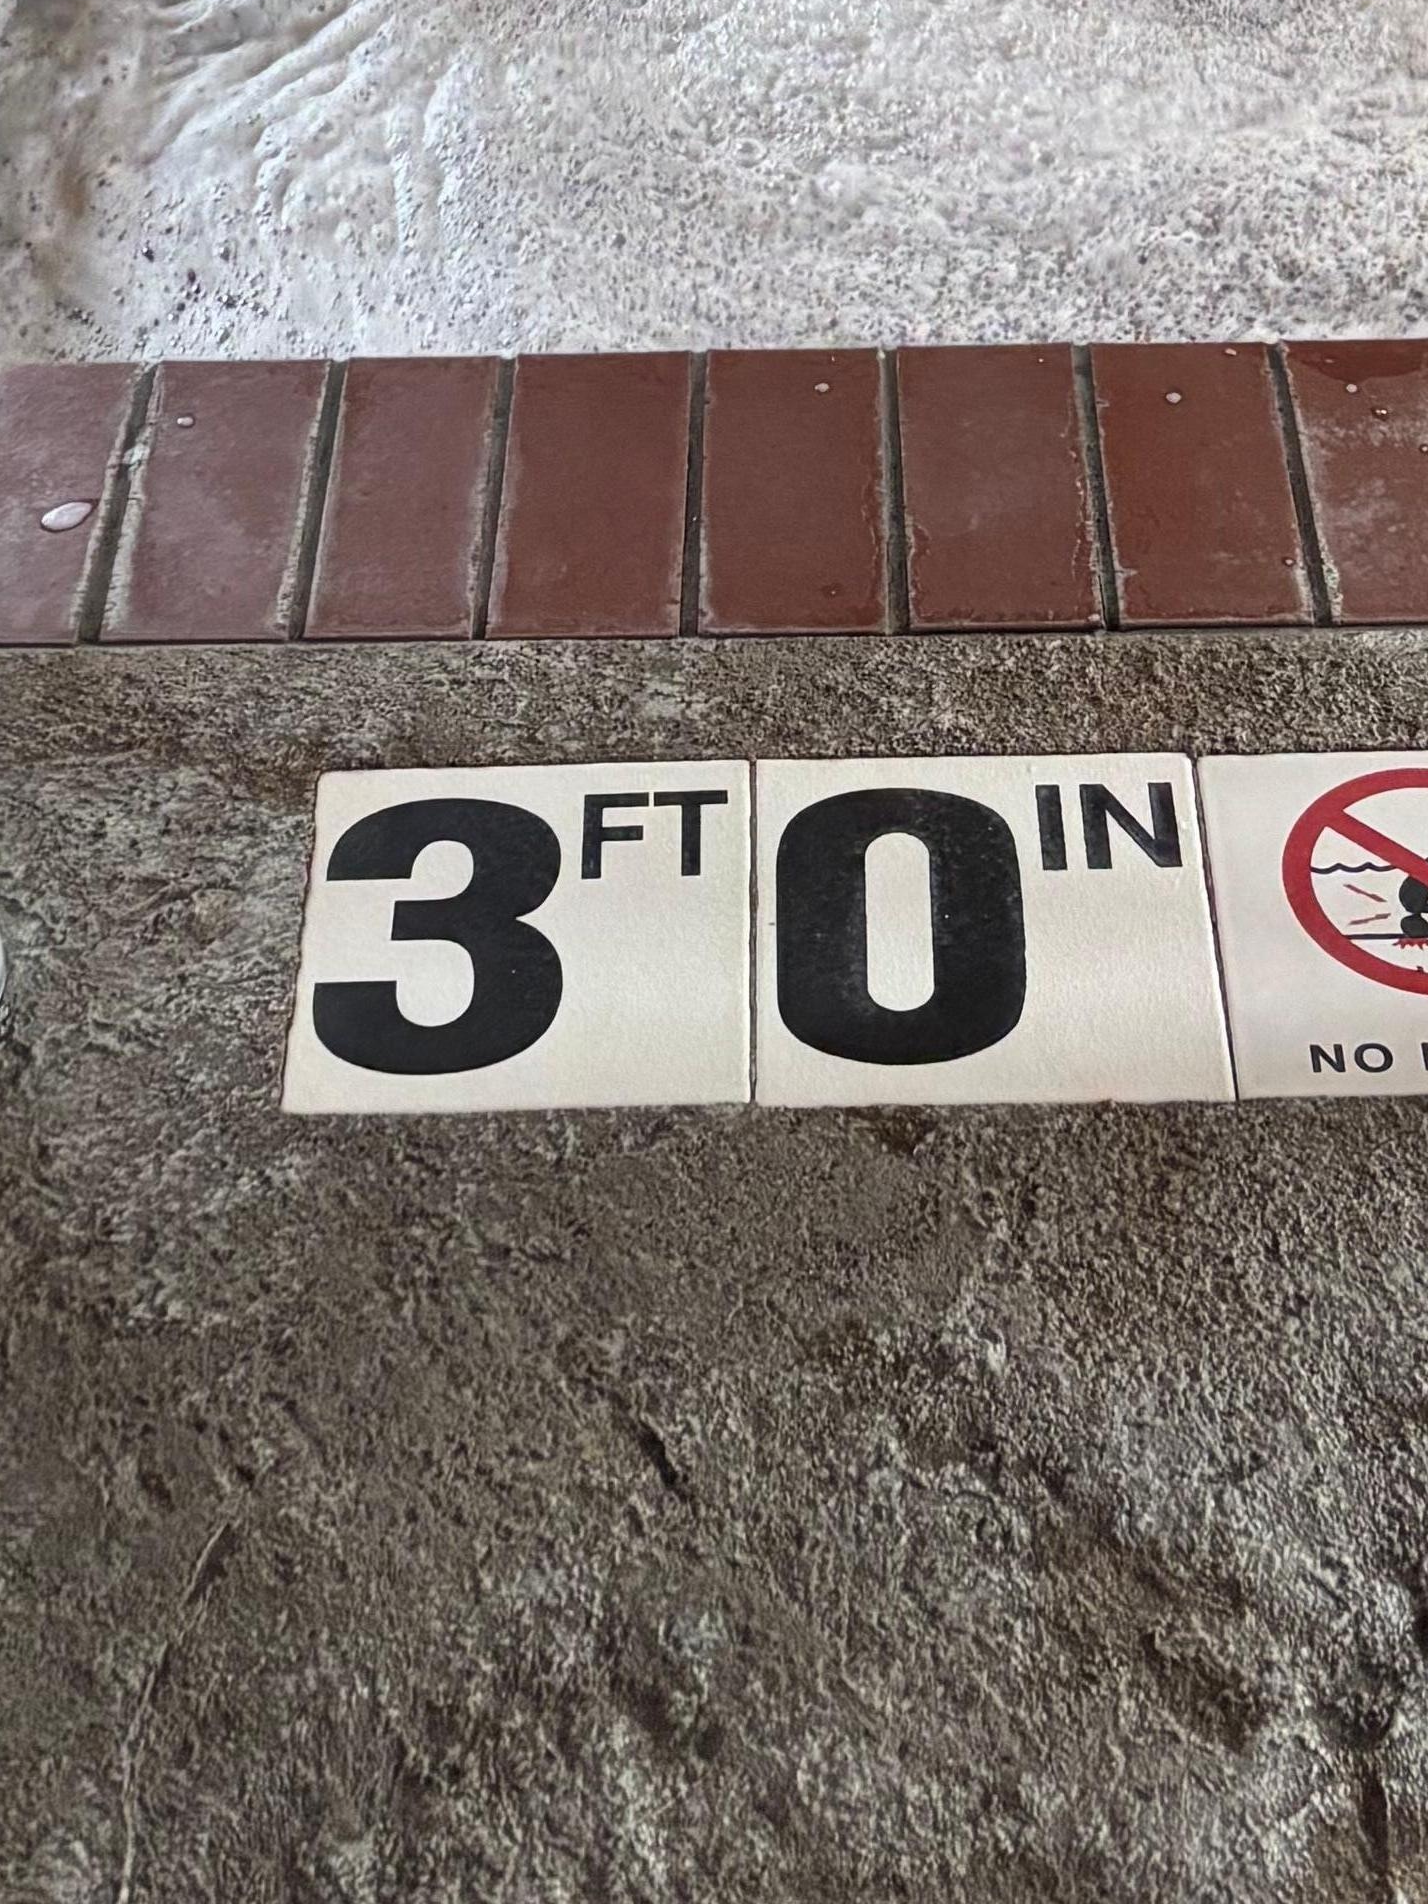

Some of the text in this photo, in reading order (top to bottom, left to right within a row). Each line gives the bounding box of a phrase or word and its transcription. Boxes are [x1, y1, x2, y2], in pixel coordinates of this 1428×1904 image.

[313, 782, 1184, 1076] 3 FT 0 IN
[1309, 1042, 1395, 1073] NO
